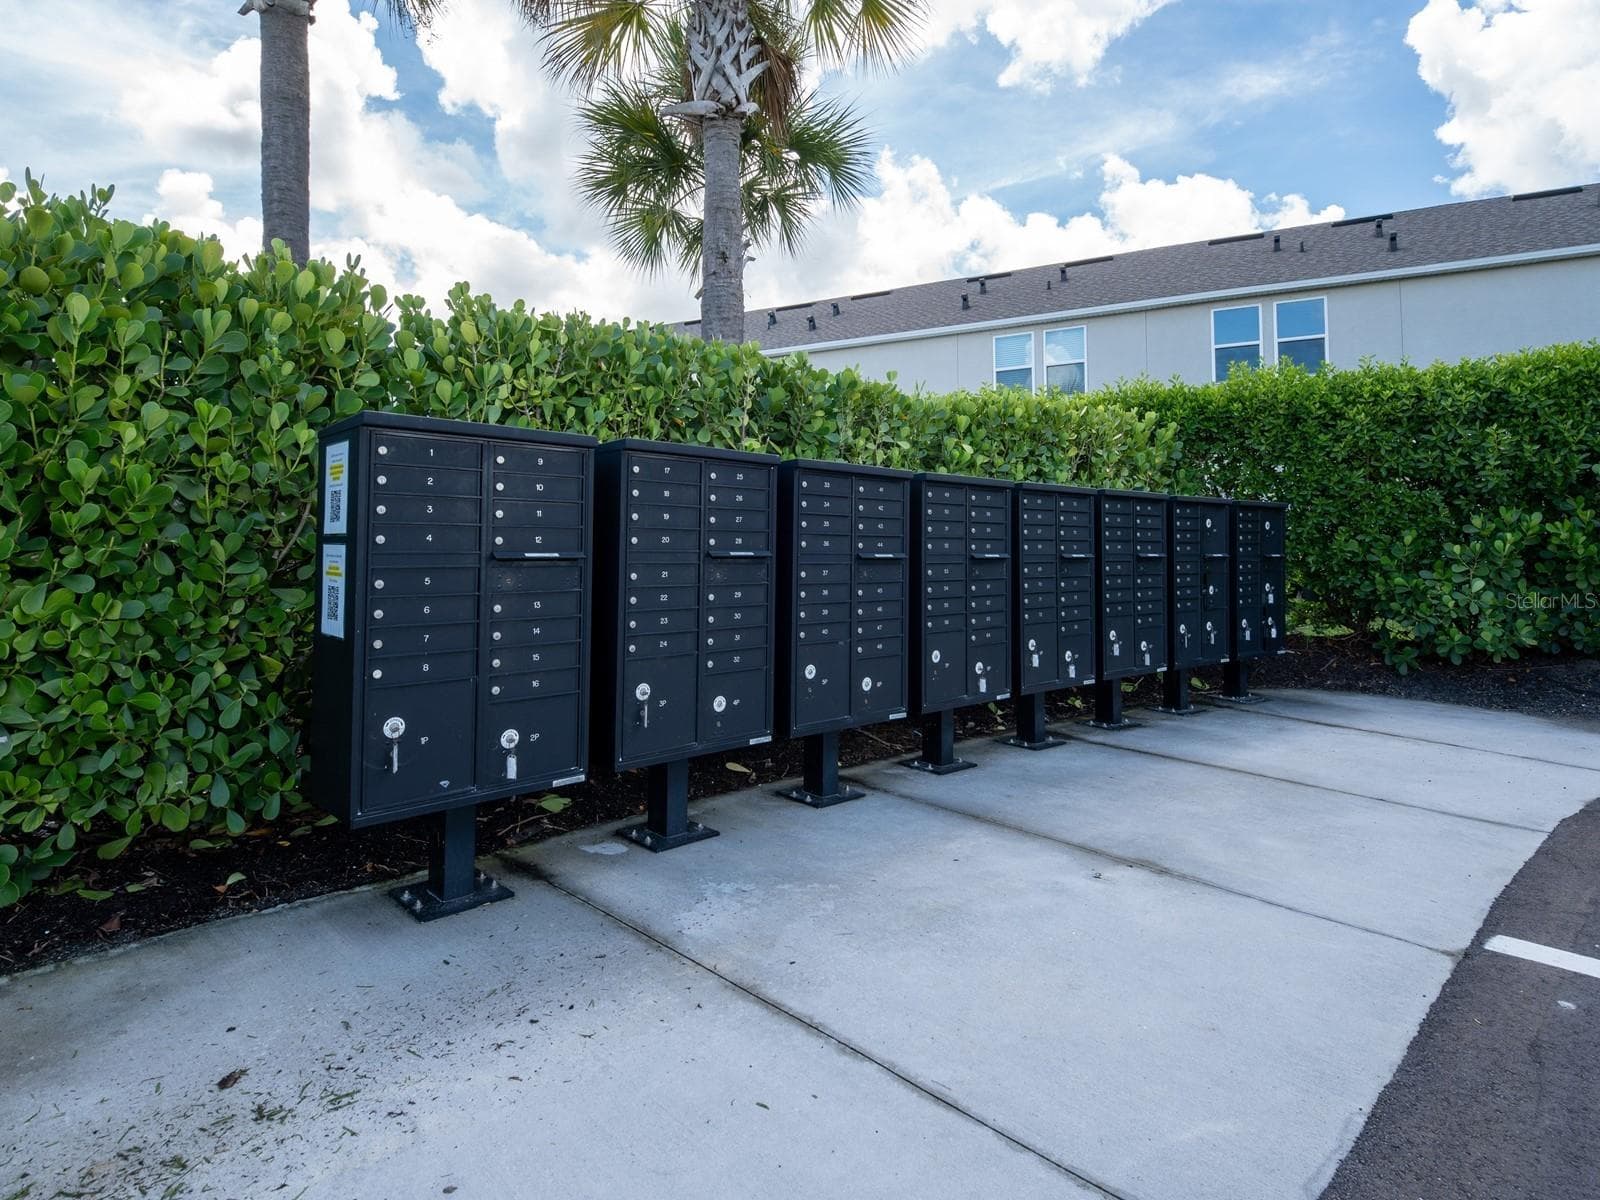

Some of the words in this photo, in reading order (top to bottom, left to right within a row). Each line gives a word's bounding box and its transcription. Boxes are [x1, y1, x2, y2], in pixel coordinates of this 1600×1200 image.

[430, 448, 434, 457] 1
[537, 457, 544, 466] 9
[736, 473, 744, 481] 25
[427, 477, 434, 486] 2
[535, 483, 544, 492] 10
[426, 505, 433, 514] 3
[536, 509, 542, 518] 11
[663, 513, 670, 521] 19
[425, 534, 433, 542] 4
[534, 536, 543, 544] 12
[661, 536, 670, 544] 20
[661, 570, 669, 578] 21
[423, 577, 431, 585] 5
[659, 593, 668, 601] 22
[734, 591, 742, 599] 29
[533, 600, 541, 609] 13
[423, 605, 431, 614] 6
[733, 612, 742, 620] 30
[660, 617, 669, 625] 23
[532, 627, 541, 635] 14
[423, 634, 430, 643] 7
[659, 640, 668, 648] 24
[532, 653, 540, 661] 15
[422, 663, 430, 672] 8
[531, 679, 540, 688] 16
[420, 736, 429, 745] 1P
[529, 733, 540, 742] 2P
